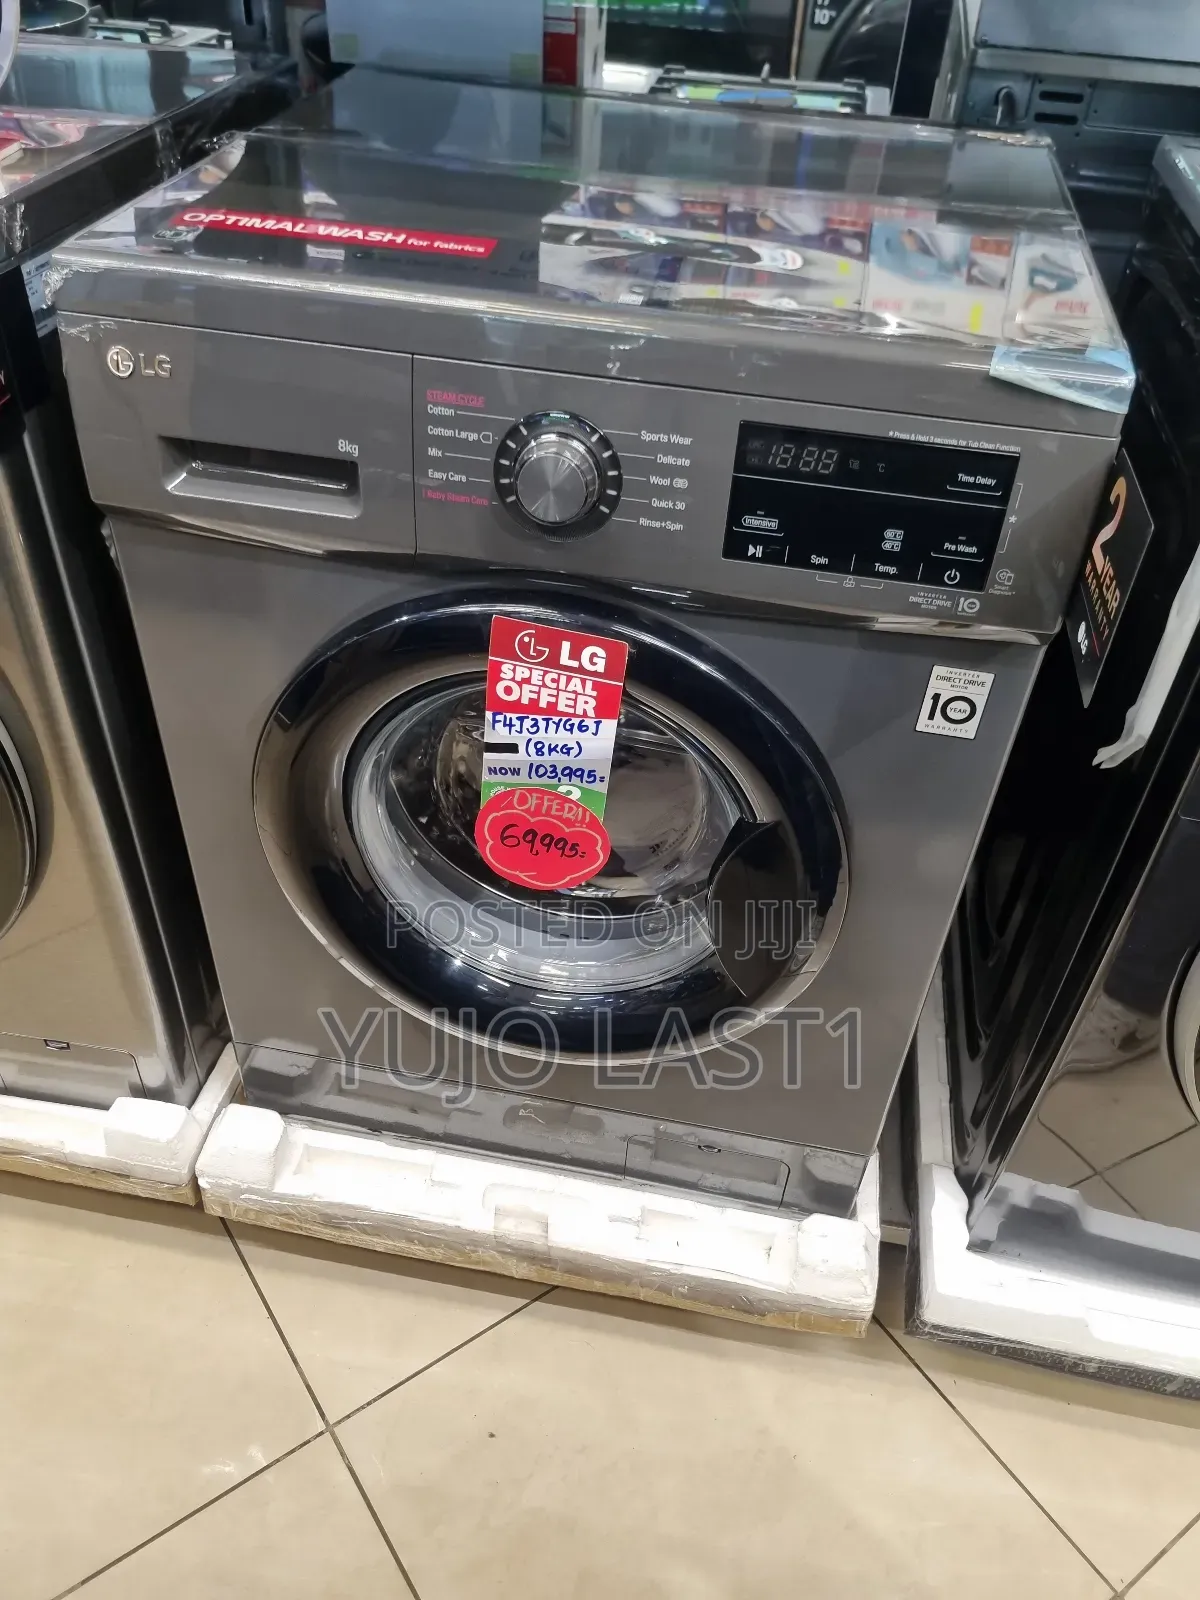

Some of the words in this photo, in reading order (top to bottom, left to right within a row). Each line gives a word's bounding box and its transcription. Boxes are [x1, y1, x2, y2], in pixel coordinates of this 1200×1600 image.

[407, 238, 430, 248] for
[433, 241, 486, 253] fabrics
[138, 352, 172, 378] LG
[426, 389, 457, 403] STEAM
[458, 393, 485, 407] CYCLE
[427, 404, 455, 417] Cotton
[427, 425, 454, 437] Cotton
[455, 429, 479, 442] Large
[640, 430, 669, 443] Sports
[669, 433, 693, 446] Wear
[337, 438, 359, 458] 8kg
[893, 430, 910, 441] Press
[910, 433, 916, 441] &
[915, 433, 929, 443] Hold
[933, 436, 958, 446] seconds
[958, 439, 968, 447] for
[968, 440, 979, 448] Tub
[979, 441, 996, 451] Clean
[995, 444, 1021, 453] Function
[427, 446, 443, 458] Mix
[656, 453, 691, 467] Delicate
[428, 469, 447, 481] Easy
[448, 471, 467, 483] Care
[649, 475, 671, 487] Wool
[957, 472, 975, 484] Time
[975, 475, 997, 487] Delay
[427, 489, 446, 501] Baby
[447, 492, 470, 504] Steam
[471, 495, 489, 506] Care
[651, 497, 674, 510] Quick
[674, 501, 686, 511] 30
[639, 516, 684, 532] Rinse+Spin
[744, 516, 777, 529] Intensive
[1092, 476, 1127, 575] 2
[943, 542, 956, 552] Pre
[957, 543, 978, 554] Wash
[810, 554, 829, 566] Spin
[873, 562, 899, 575] Temp.
[1101, 555, 1121, 620] YEAR
[908, 596, 932, 605] DIRECT
[932, 599, 953, 608] DRIVE
[957, 597, 980, 613] 10
[1085, 560, 1109, 640] WARRANTY
[559, 640, 607, 673] LG
[500, 663, 598, 697] SPECIAL
[935, 674, 963, 684] DIRECT
[963, 678, 987, 688] DRIVE
[946, 669, 981, 679] INVERTER
[495, 680, 597, 718] OFFER
[927, 692, 977, 725] 10
[949, 706, 968, 715] YEAR
[491, 711, 603, 737] F4J3TYG6J
[924, 723, 968, 733] WARRANTY
[525, 737, 583, 758] (8KG)
[487, 766, 522, 777] NOW
